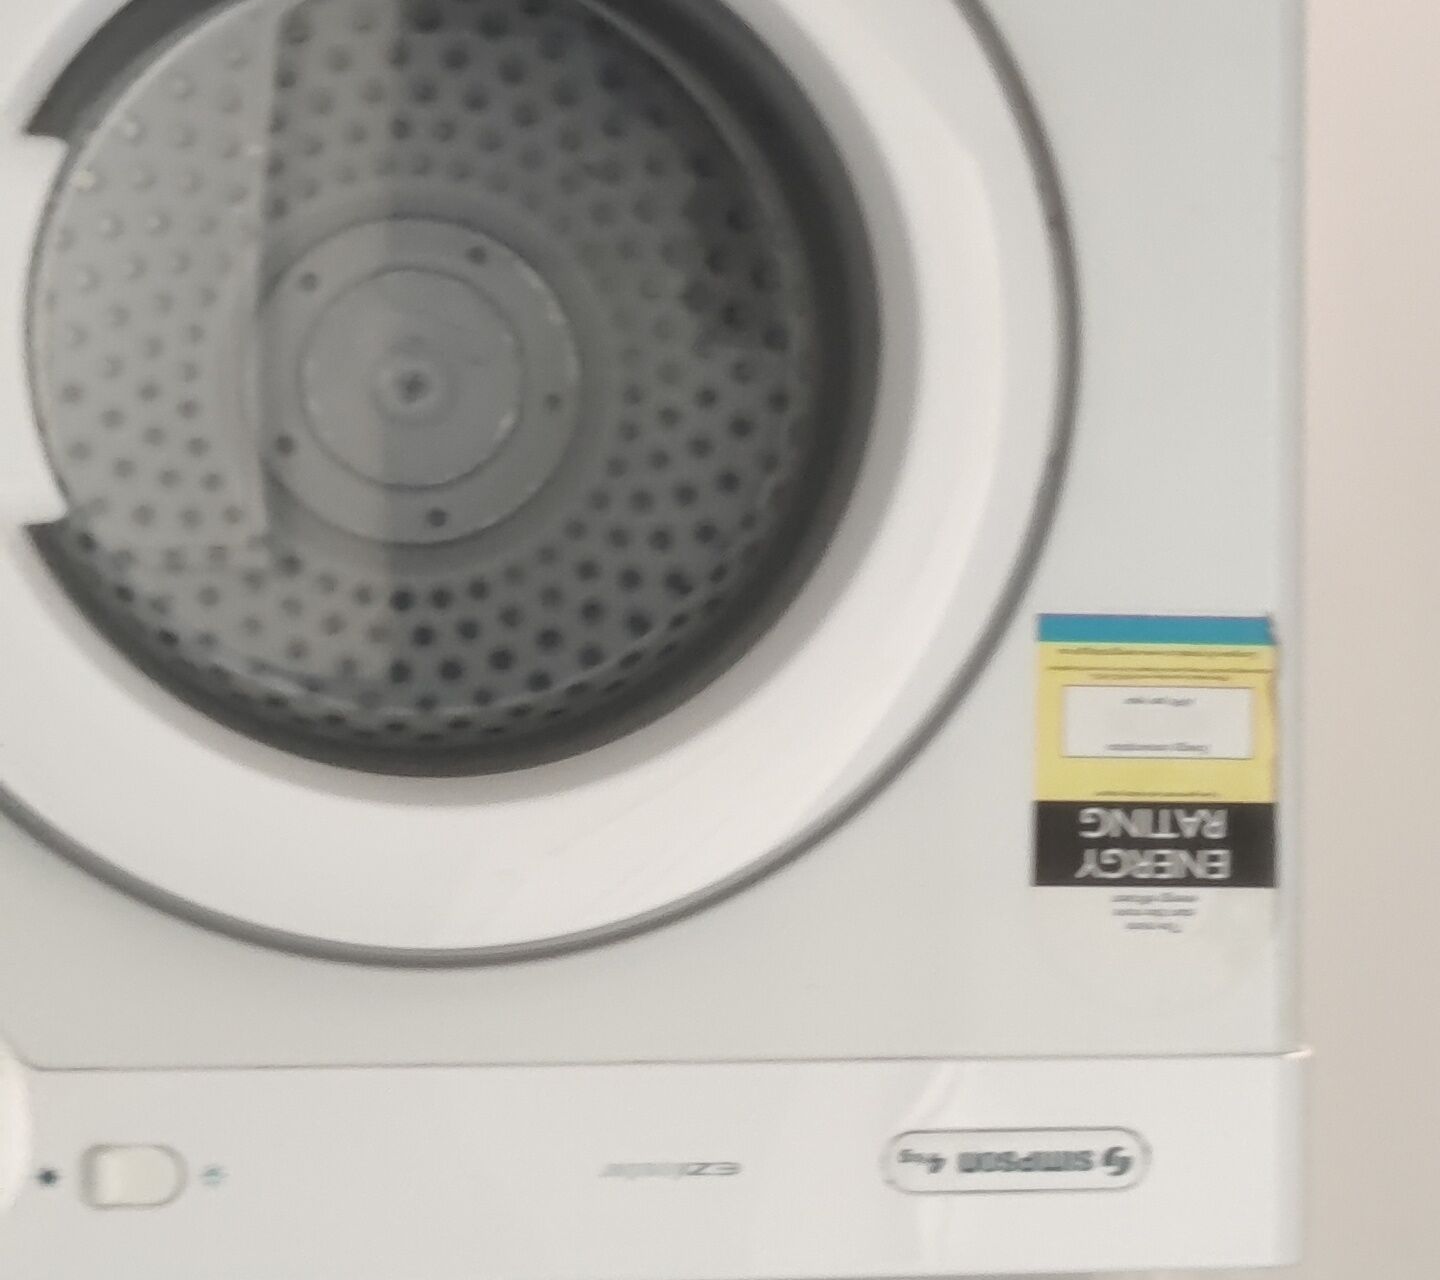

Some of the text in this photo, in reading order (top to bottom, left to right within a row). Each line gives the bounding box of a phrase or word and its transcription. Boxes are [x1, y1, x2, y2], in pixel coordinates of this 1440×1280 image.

[1078, 807, 1229, 839] RATING
[1073, 847, 1233, 879] ENERGY
[957, 1150, 1095, 1173] SIMPSON
